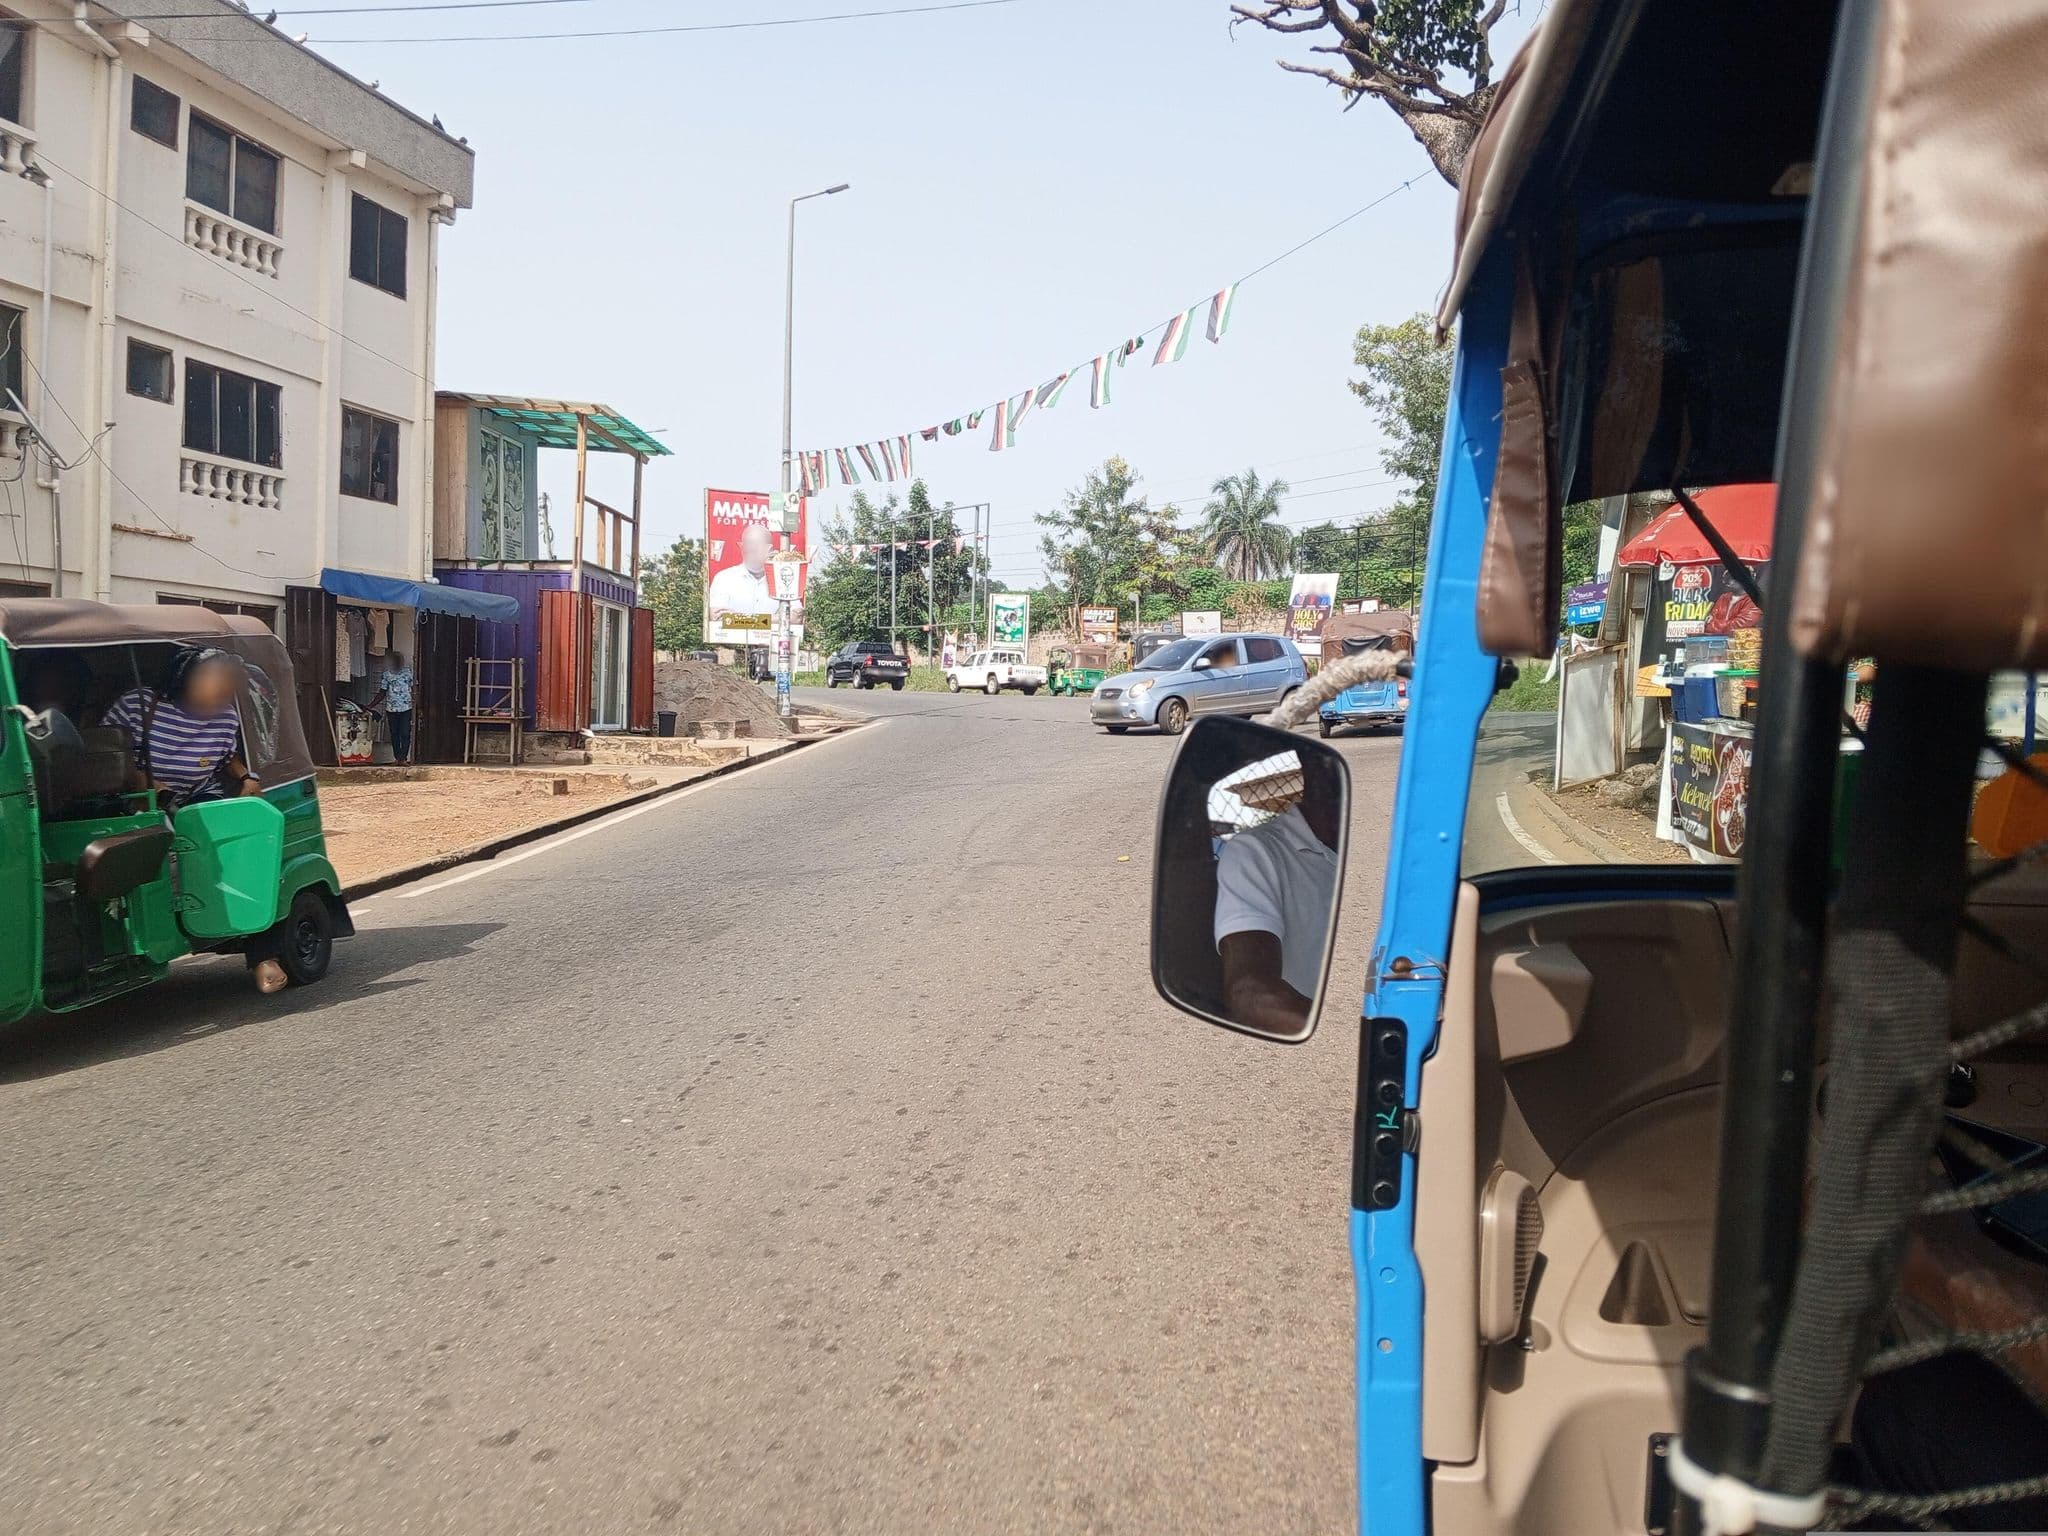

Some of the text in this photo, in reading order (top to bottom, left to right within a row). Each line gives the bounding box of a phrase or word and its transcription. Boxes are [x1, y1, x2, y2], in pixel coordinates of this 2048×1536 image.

[717, 517, 737, 526] FOR
[1673, 588, 1711, 603] BLACK
[1294, 609, 1319, 620] HOLY
[1665, 601, 1714, 620] FRIDAY
[1291, 620, 1318, 630] GHOST
[877, 659, 902, 667] TOYOTA
